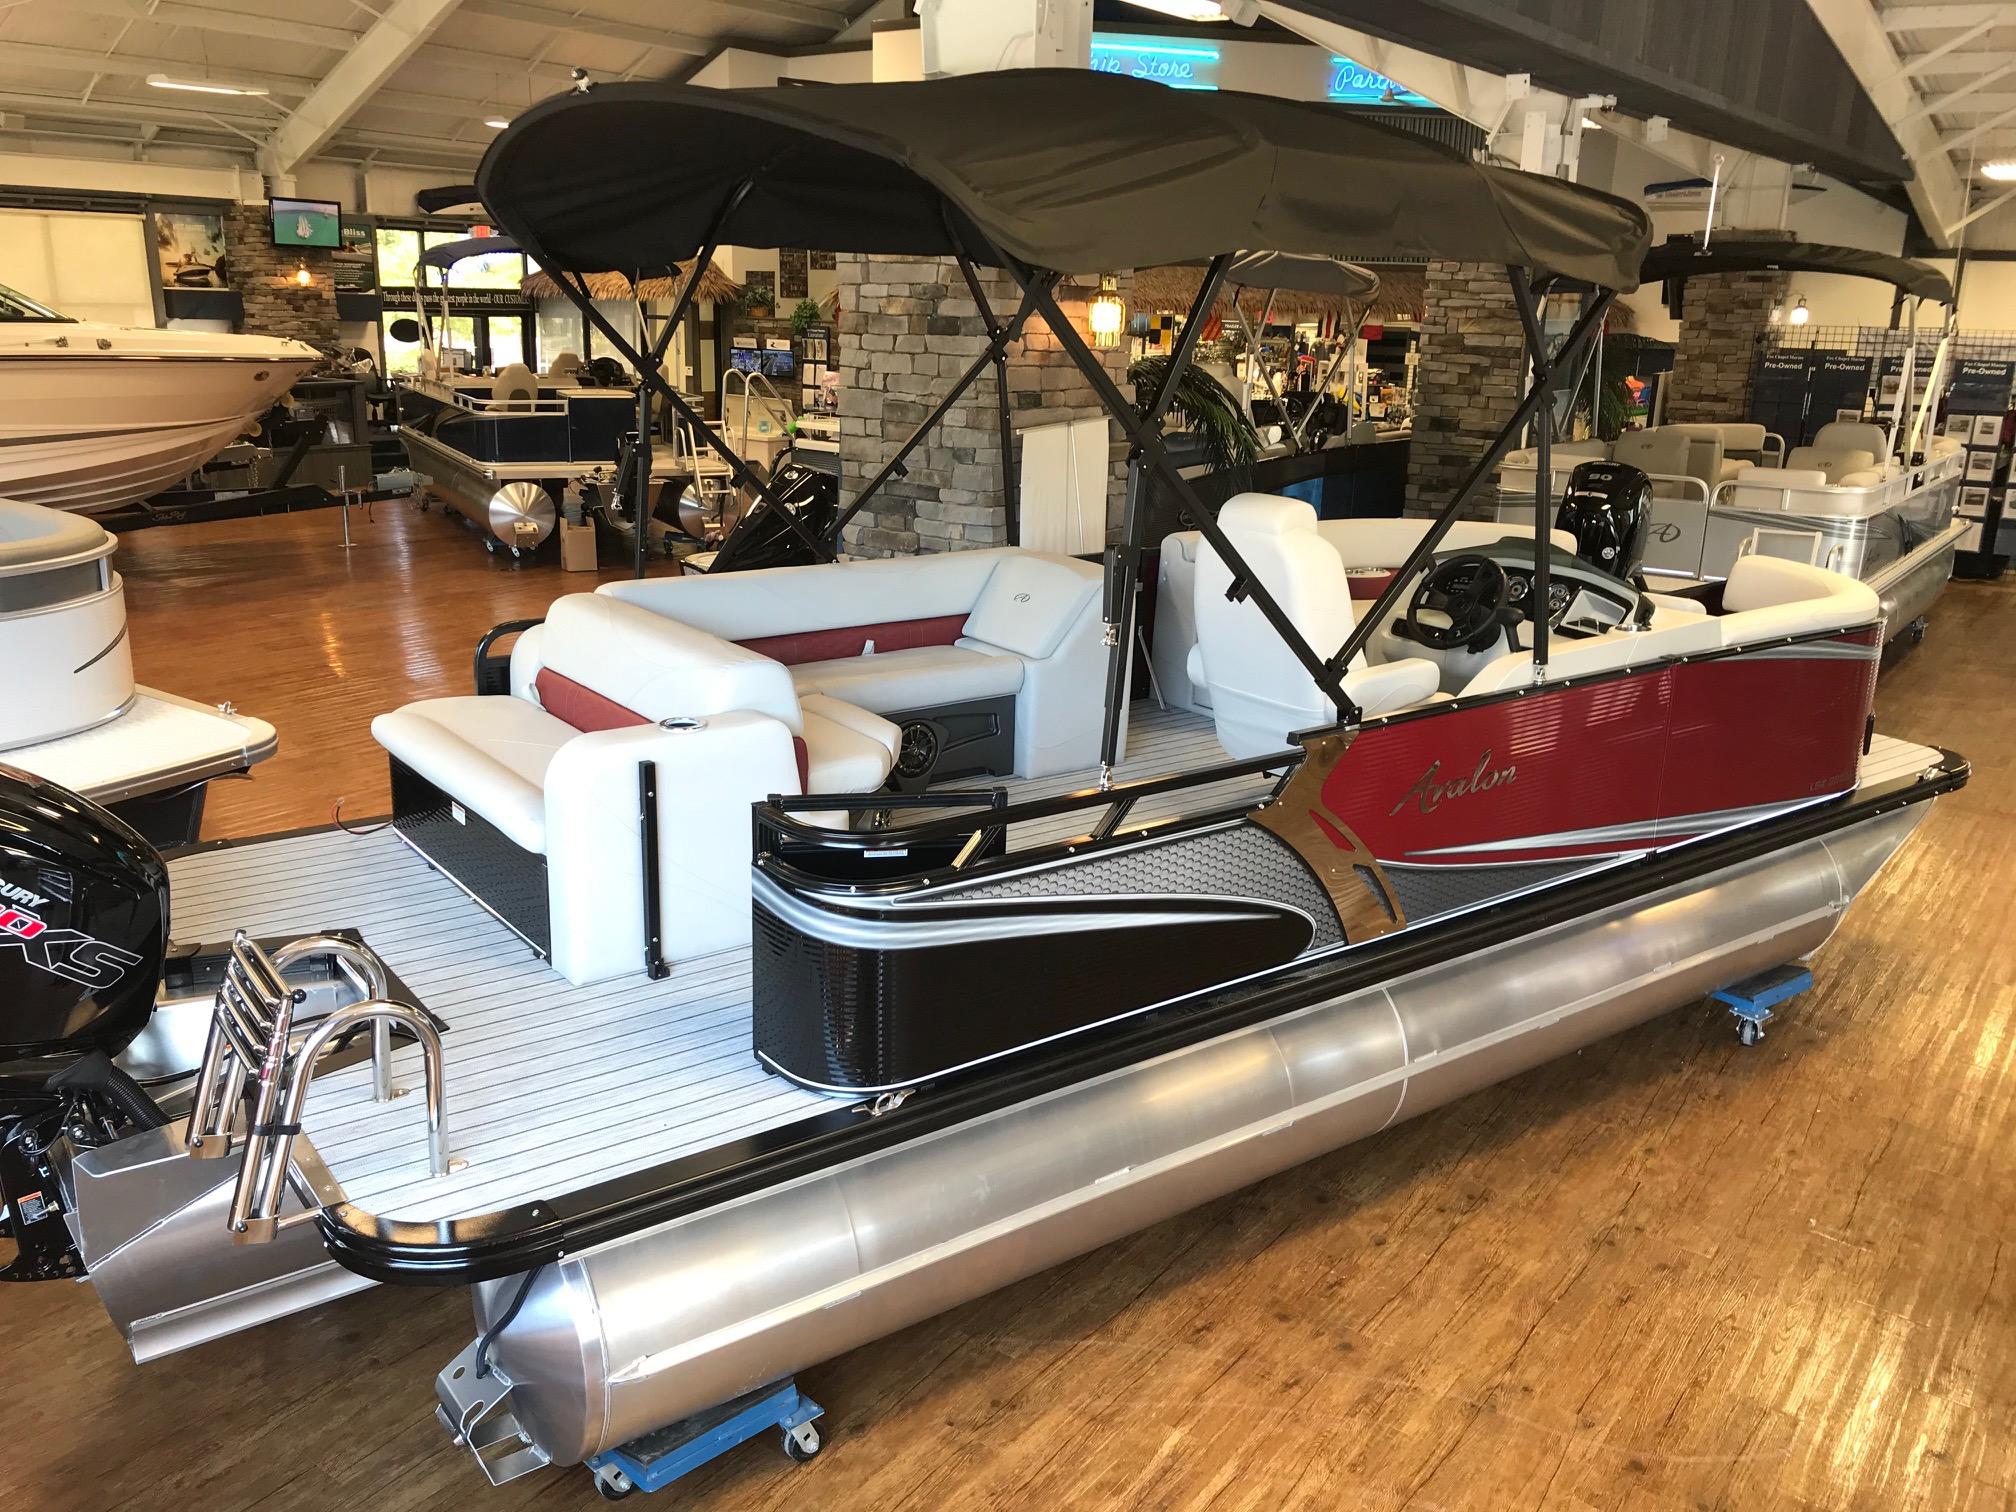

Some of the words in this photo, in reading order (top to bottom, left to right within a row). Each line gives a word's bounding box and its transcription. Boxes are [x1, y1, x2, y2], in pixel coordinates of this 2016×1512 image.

[1131, 53, 1192, 78] Store
[343, 228, 366, 236] Bliss
[382, 291, 400, 305] Through
[401, 291, 412, 302] these
[424, 294, 432, 305] pass
[455, 292, 468, 306] people
[480, 293, 491, 303] world
[493, 294, 504, 304] OUR
[1764, 361, 1803, 370] Pre-Owned
[1824, 362, 1865, 371] Pre-Owned
[1962, 367, 2007, 376] Pre-Owned
[1389, 749, 1519, 817] Avalon
